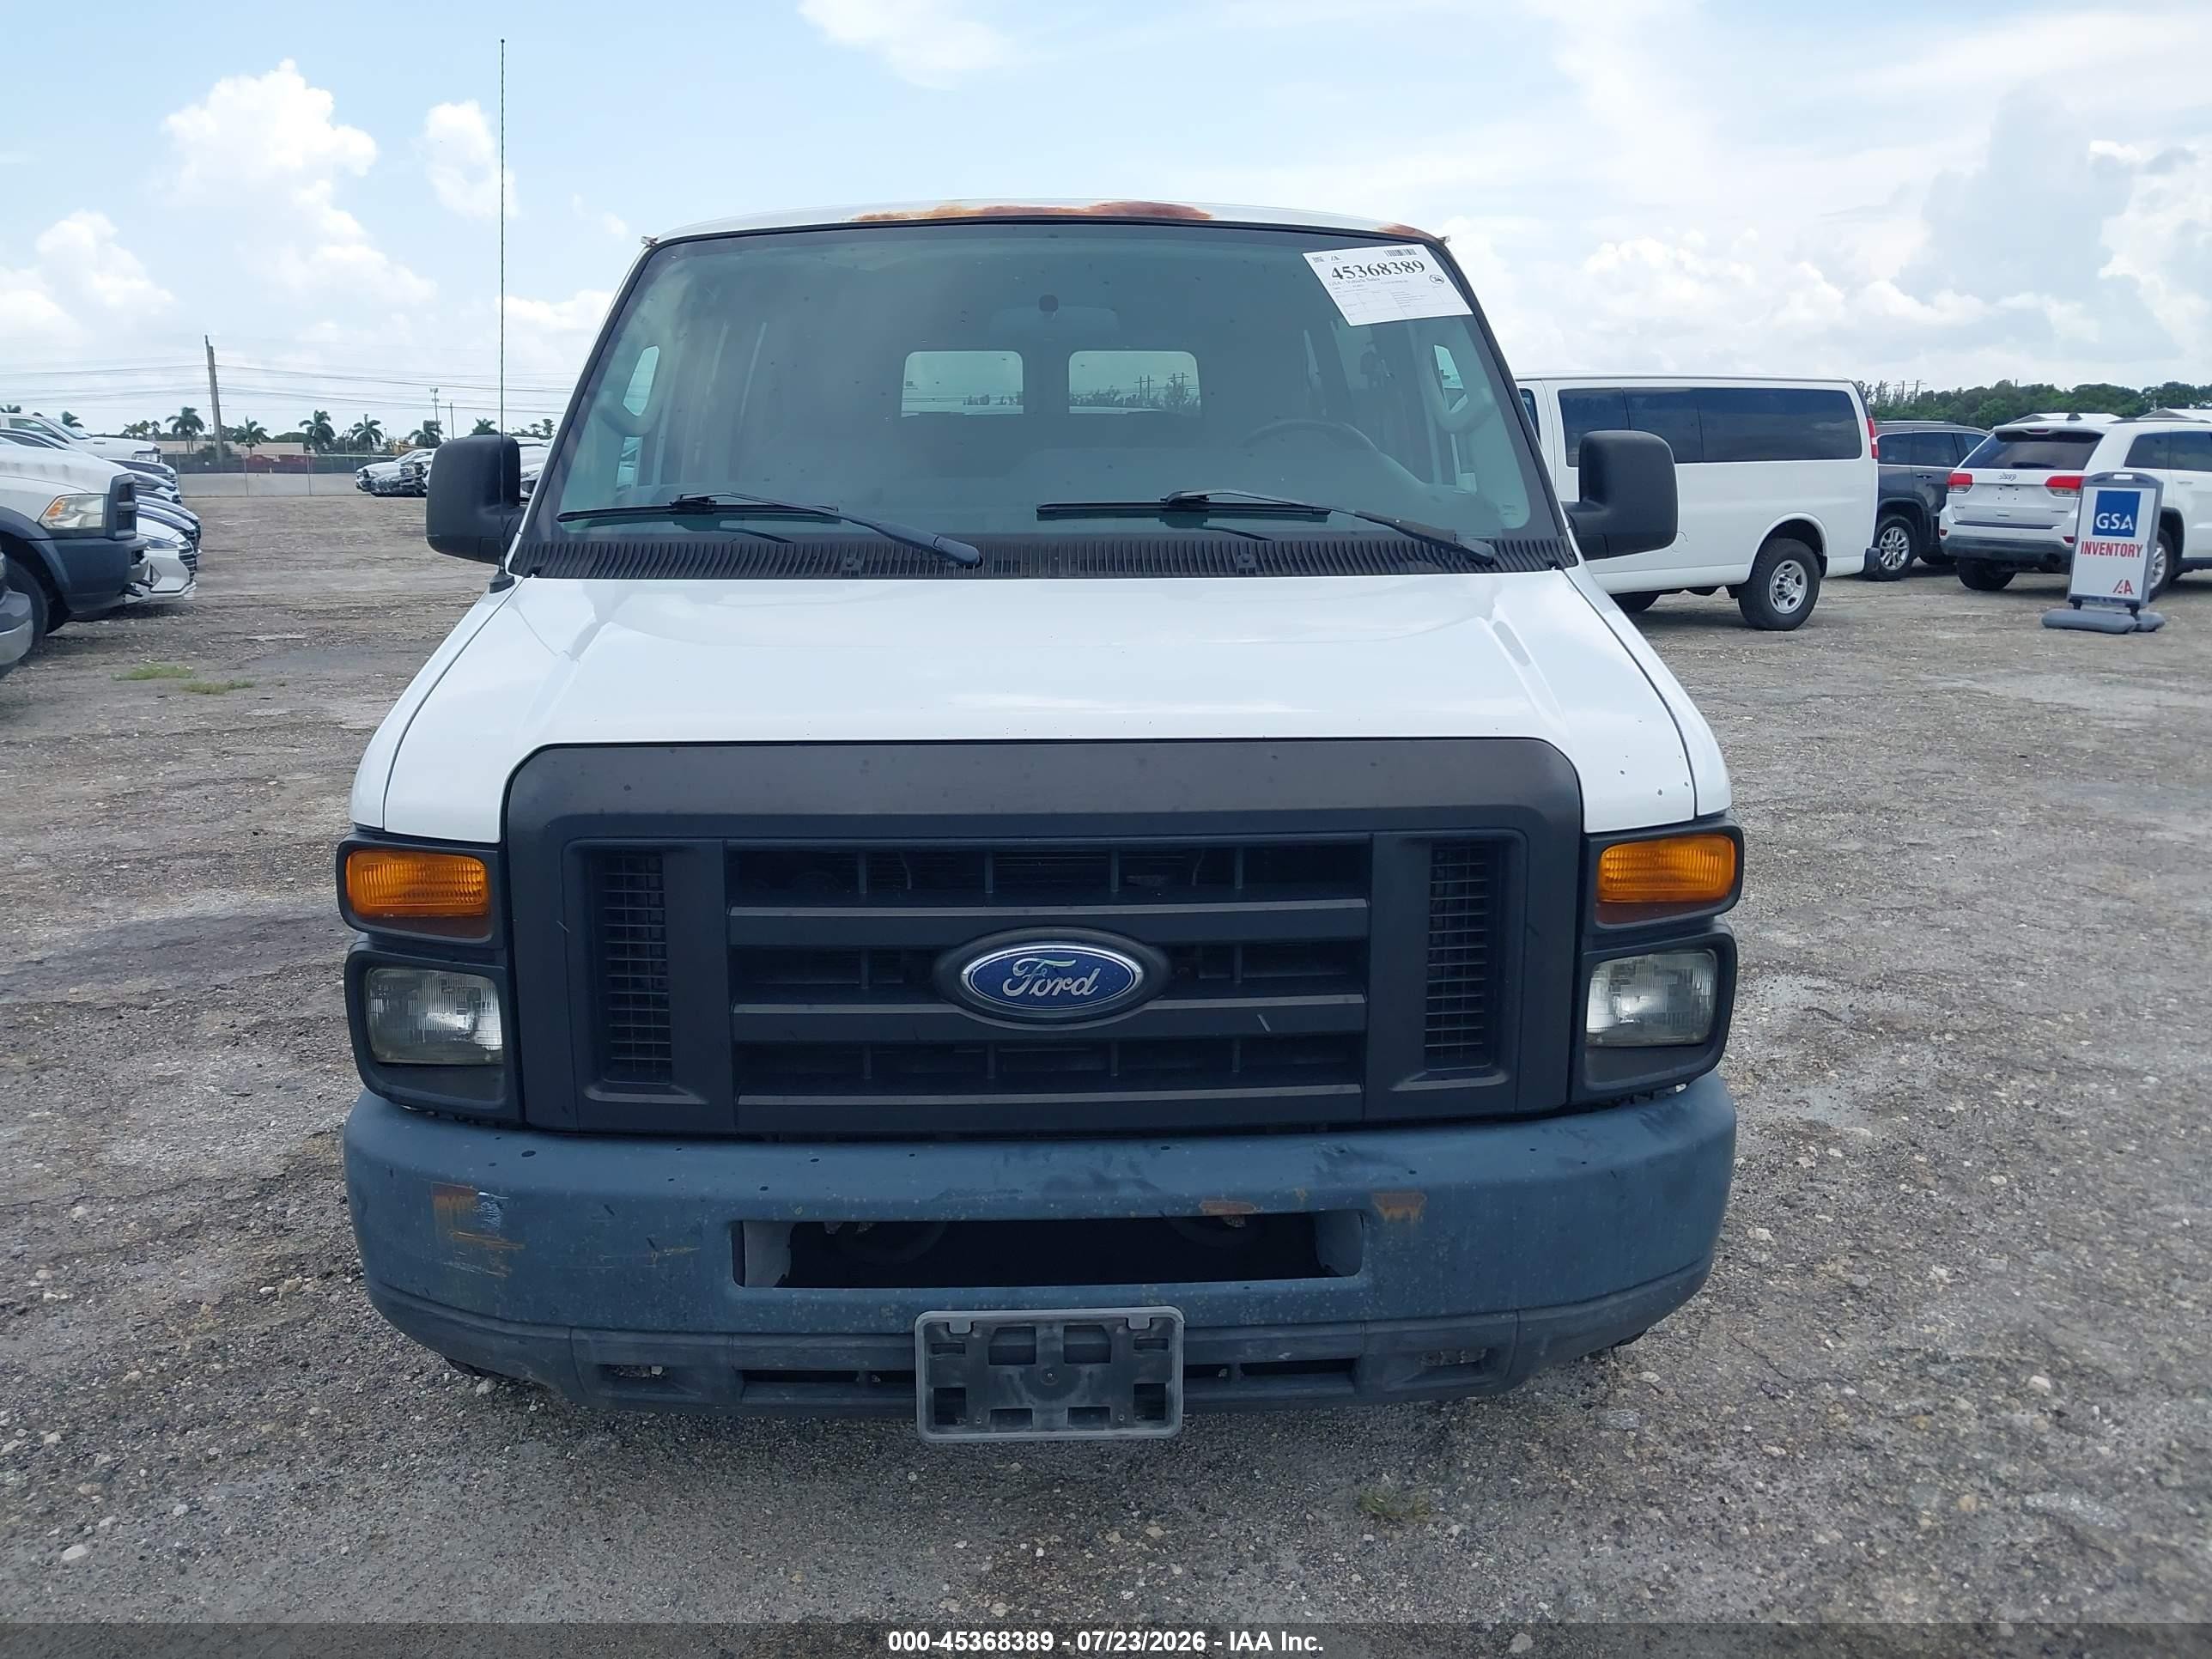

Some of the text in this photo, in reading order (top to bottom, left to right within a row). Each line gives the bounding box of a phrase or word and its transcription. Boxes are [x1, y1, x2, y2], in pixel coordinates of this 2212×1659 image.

[1331, 259, 1425, 280] 45368389
[2095, 512, 2134, 531] GSA
[2080, 540, 2144, 558] INVENTORY
[1002, 957, 1101, 996] Ford
